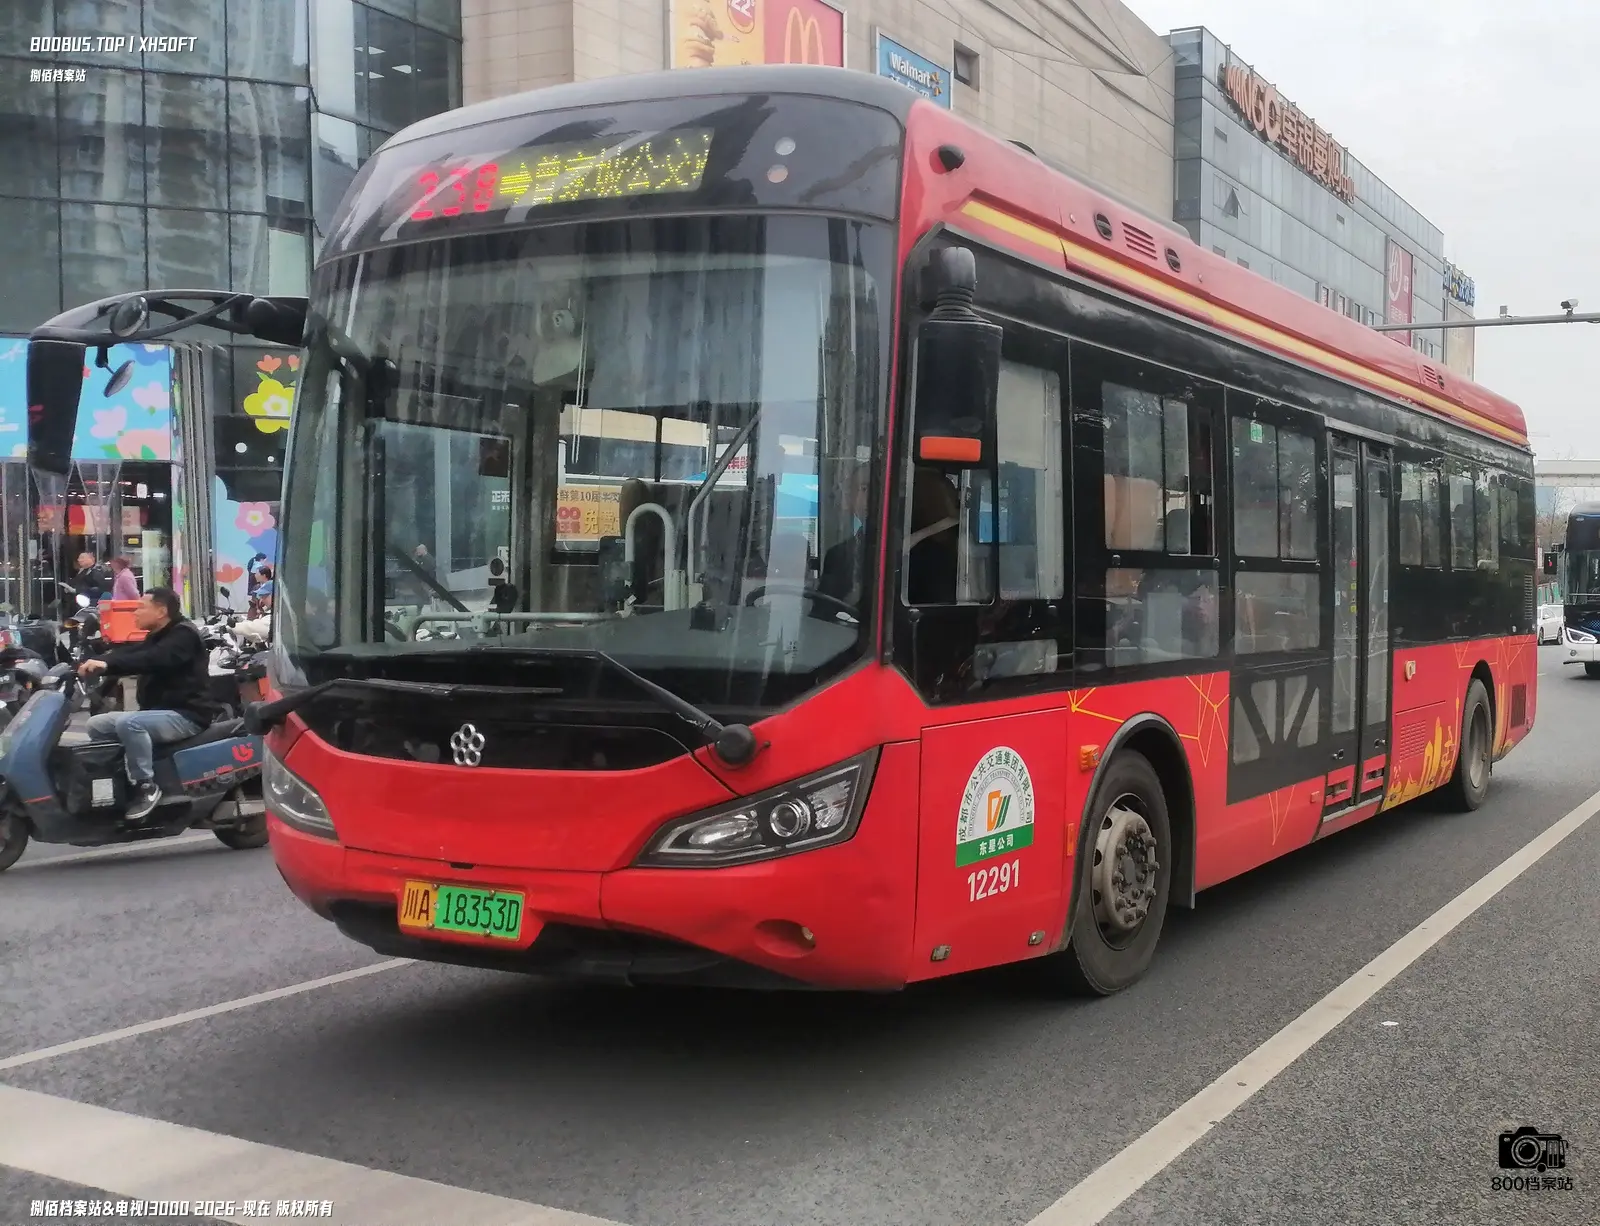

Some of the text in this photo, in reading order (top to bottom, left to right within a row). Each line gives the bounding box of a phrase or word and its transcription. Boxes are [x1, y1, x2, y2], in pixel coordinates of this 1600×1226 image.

[889, 52, 931, 88] Walmart
[411, 163, 499, 220] 238
[958, 750, 1033, 842] 成都市公共交通集团有限公司
[979, 833, 1014, 856] 东星公司
[967, 859, 1020, 902] 12291
